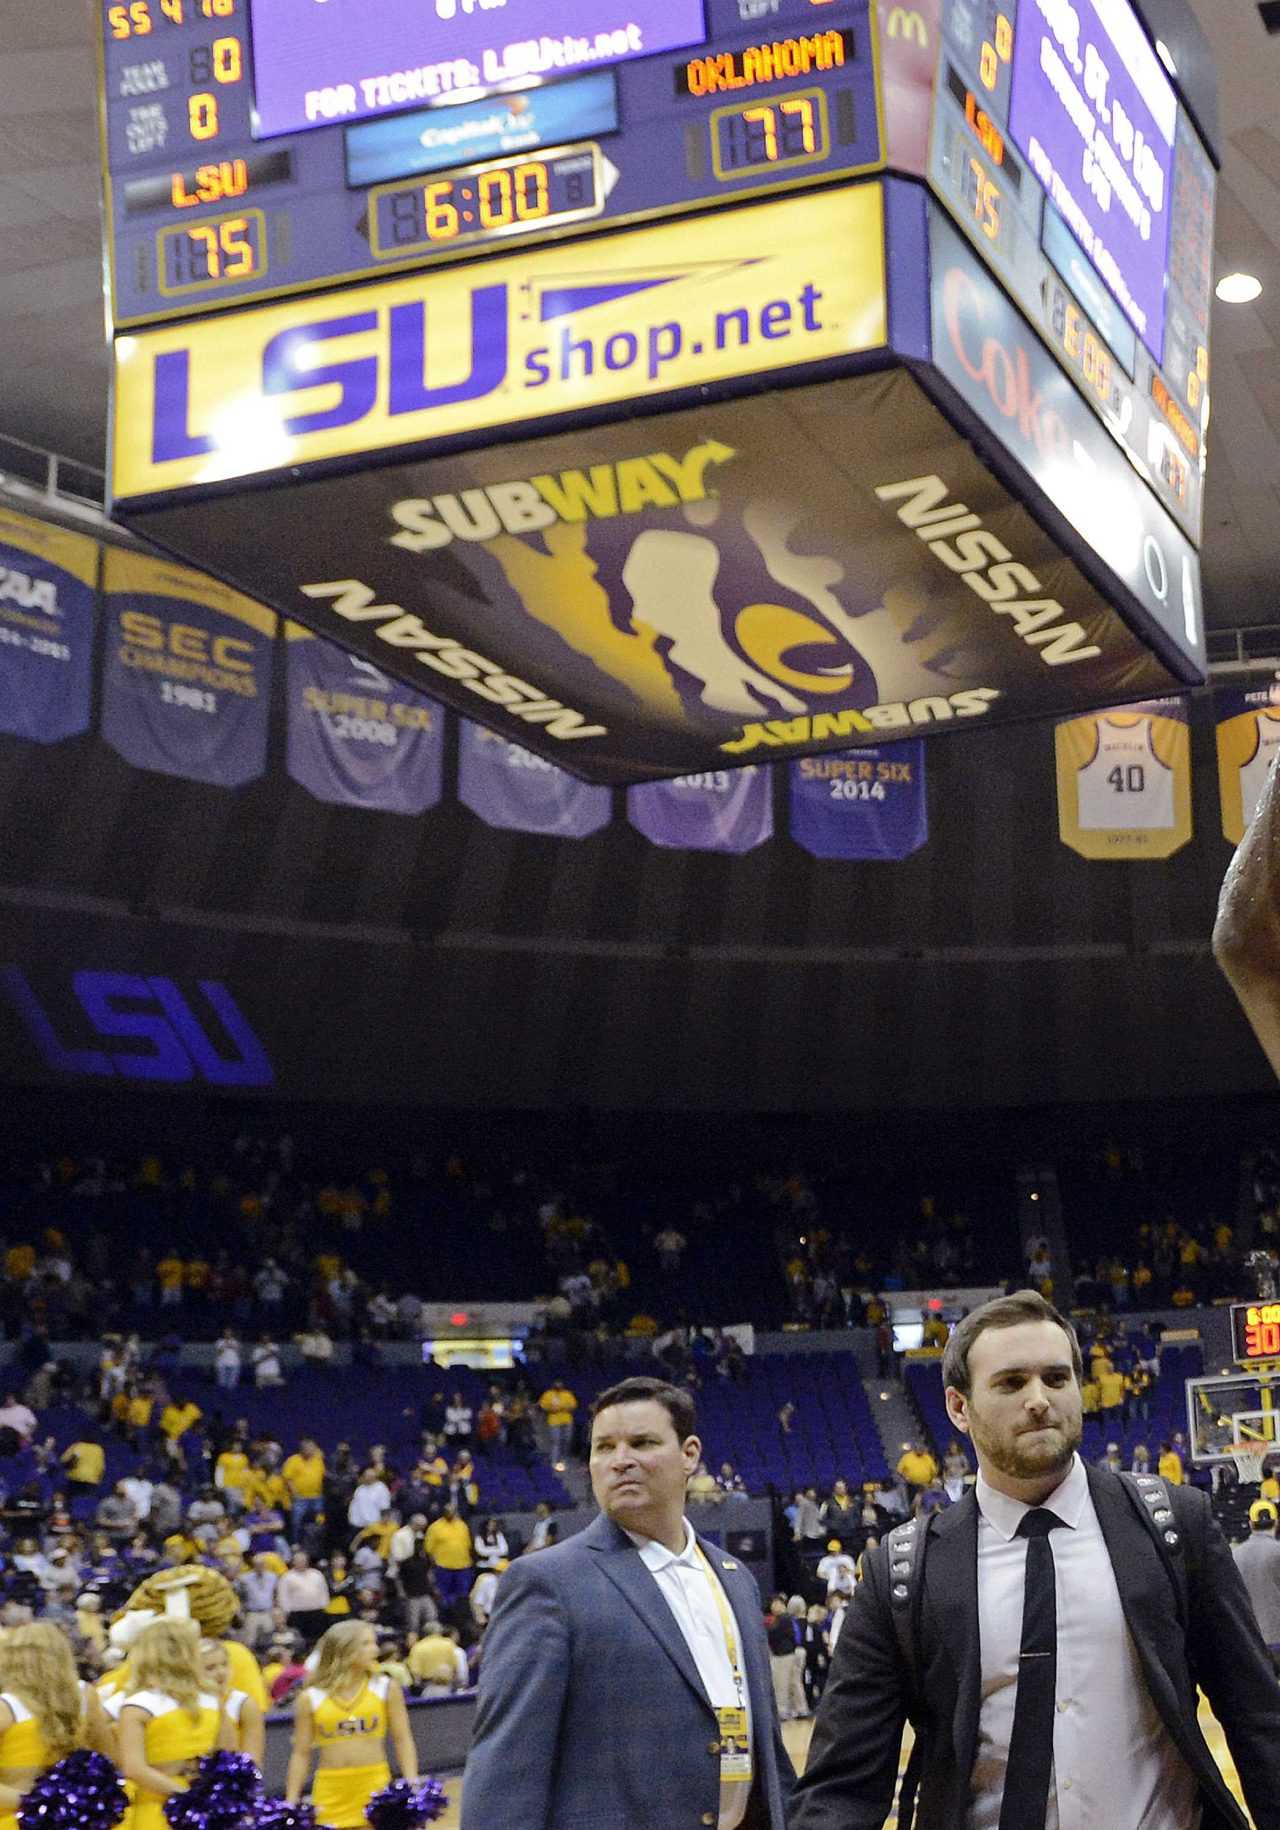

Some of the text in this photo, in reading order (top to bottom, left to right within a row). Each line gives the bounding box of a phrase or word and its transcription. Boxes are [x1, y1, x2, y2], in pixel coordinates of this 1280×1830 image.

[213, 37, 241, 84] 0
[687, 30, 845, 96] OKLAHOMA
[188, 92, 219, 140] 0
[305, 85, 356, 120] FOR
[743, 98, 815, 160] 77
[171, 159, 248, 208] LSU
[424, 162, 549, 241] 6:00
[187, 218, 254, 279] 75
[152, 282, 824, 463] LSU shop.net
[390, 439, 736, 553] SUBWAY
[874, 473, 1101, 667] NISSAN
[120, 611, 256, 673] SEC
[300, 578, 608, 741] NISSAN
[719, 687, 1002, 755] SUBWAY
[800, 757, 912, 783] SUPER SIX
[830, 779, 886, 801] 2014
[1107, 763, 1145, 793] 40
[0, 963, 275, 1087] LSU
[319, 1714, 379, 1739] LSU
